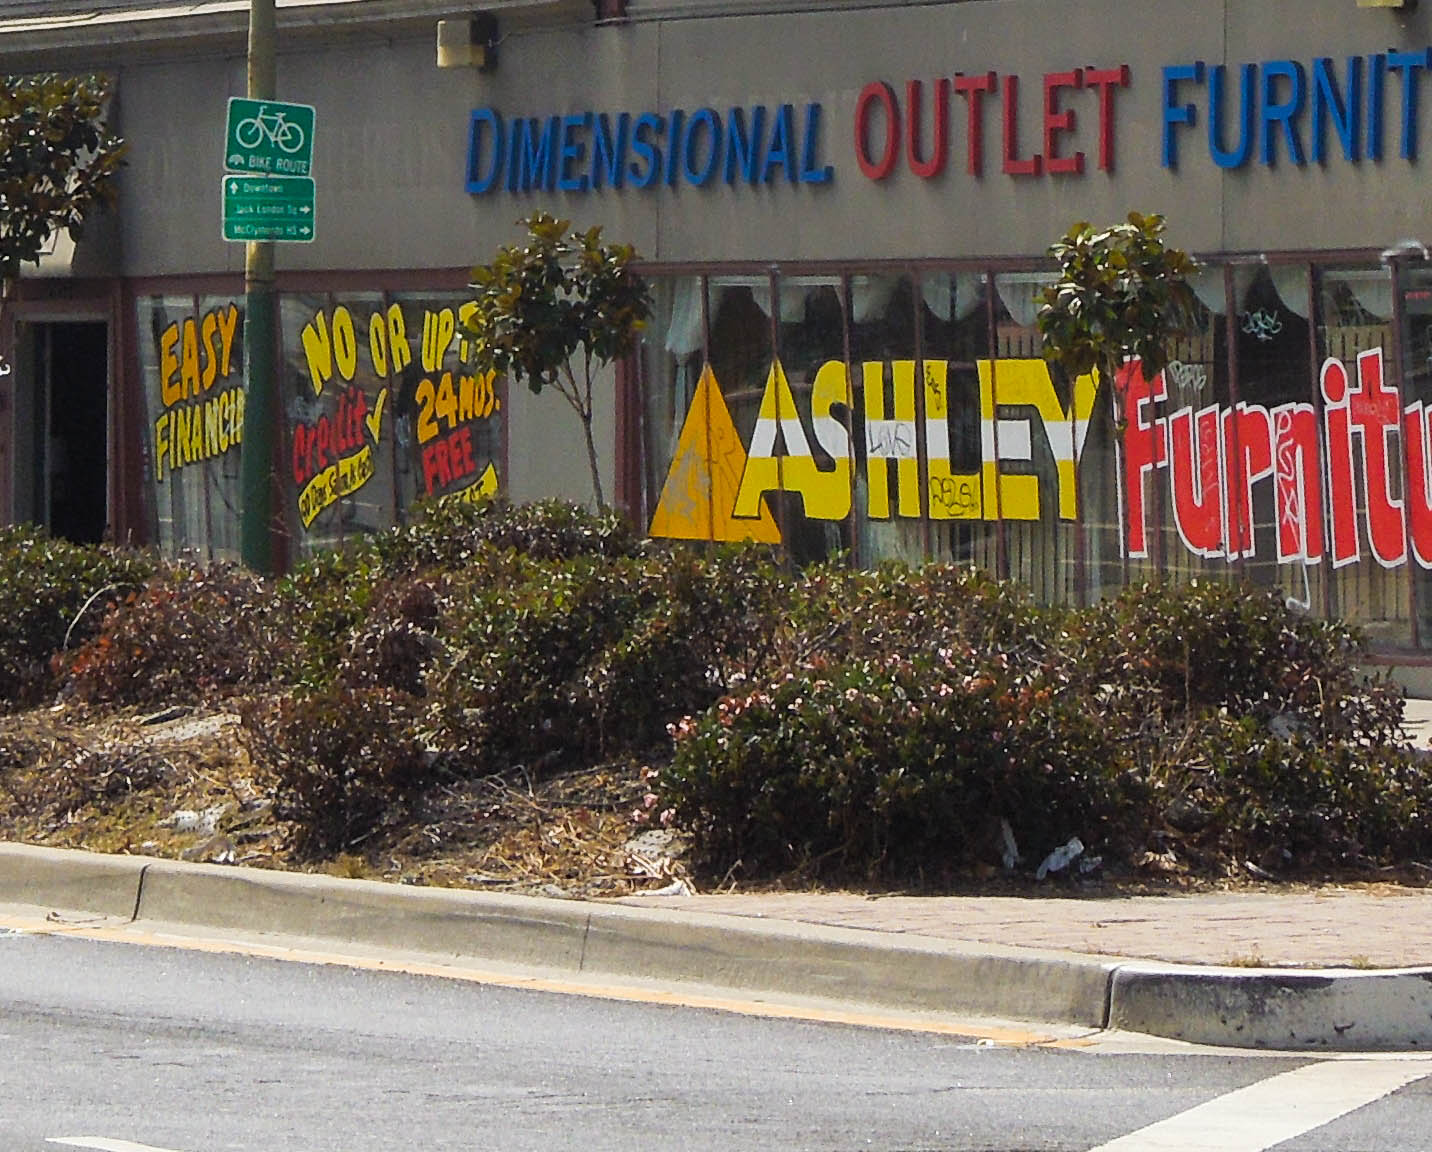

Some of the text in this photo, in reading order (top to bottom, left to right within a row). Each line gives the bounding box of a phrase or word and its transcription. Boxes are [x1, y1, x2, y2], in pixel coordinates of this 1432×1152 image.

[248, 154, 308, 174] BIKE ROUTE
[464, 101, 834, 194] DIMENSIONAL
[854, 64, 1130, 180] OUTLET
[160, 301, 239, 408] EASY
[300, 304, 358, 397] NO
[368, 301, 412, 378] OR
[415, 371, 458, 444] 24
[731, 357, 1101, 522] ASHLEY
[421, 425, 476, 497] FREE
